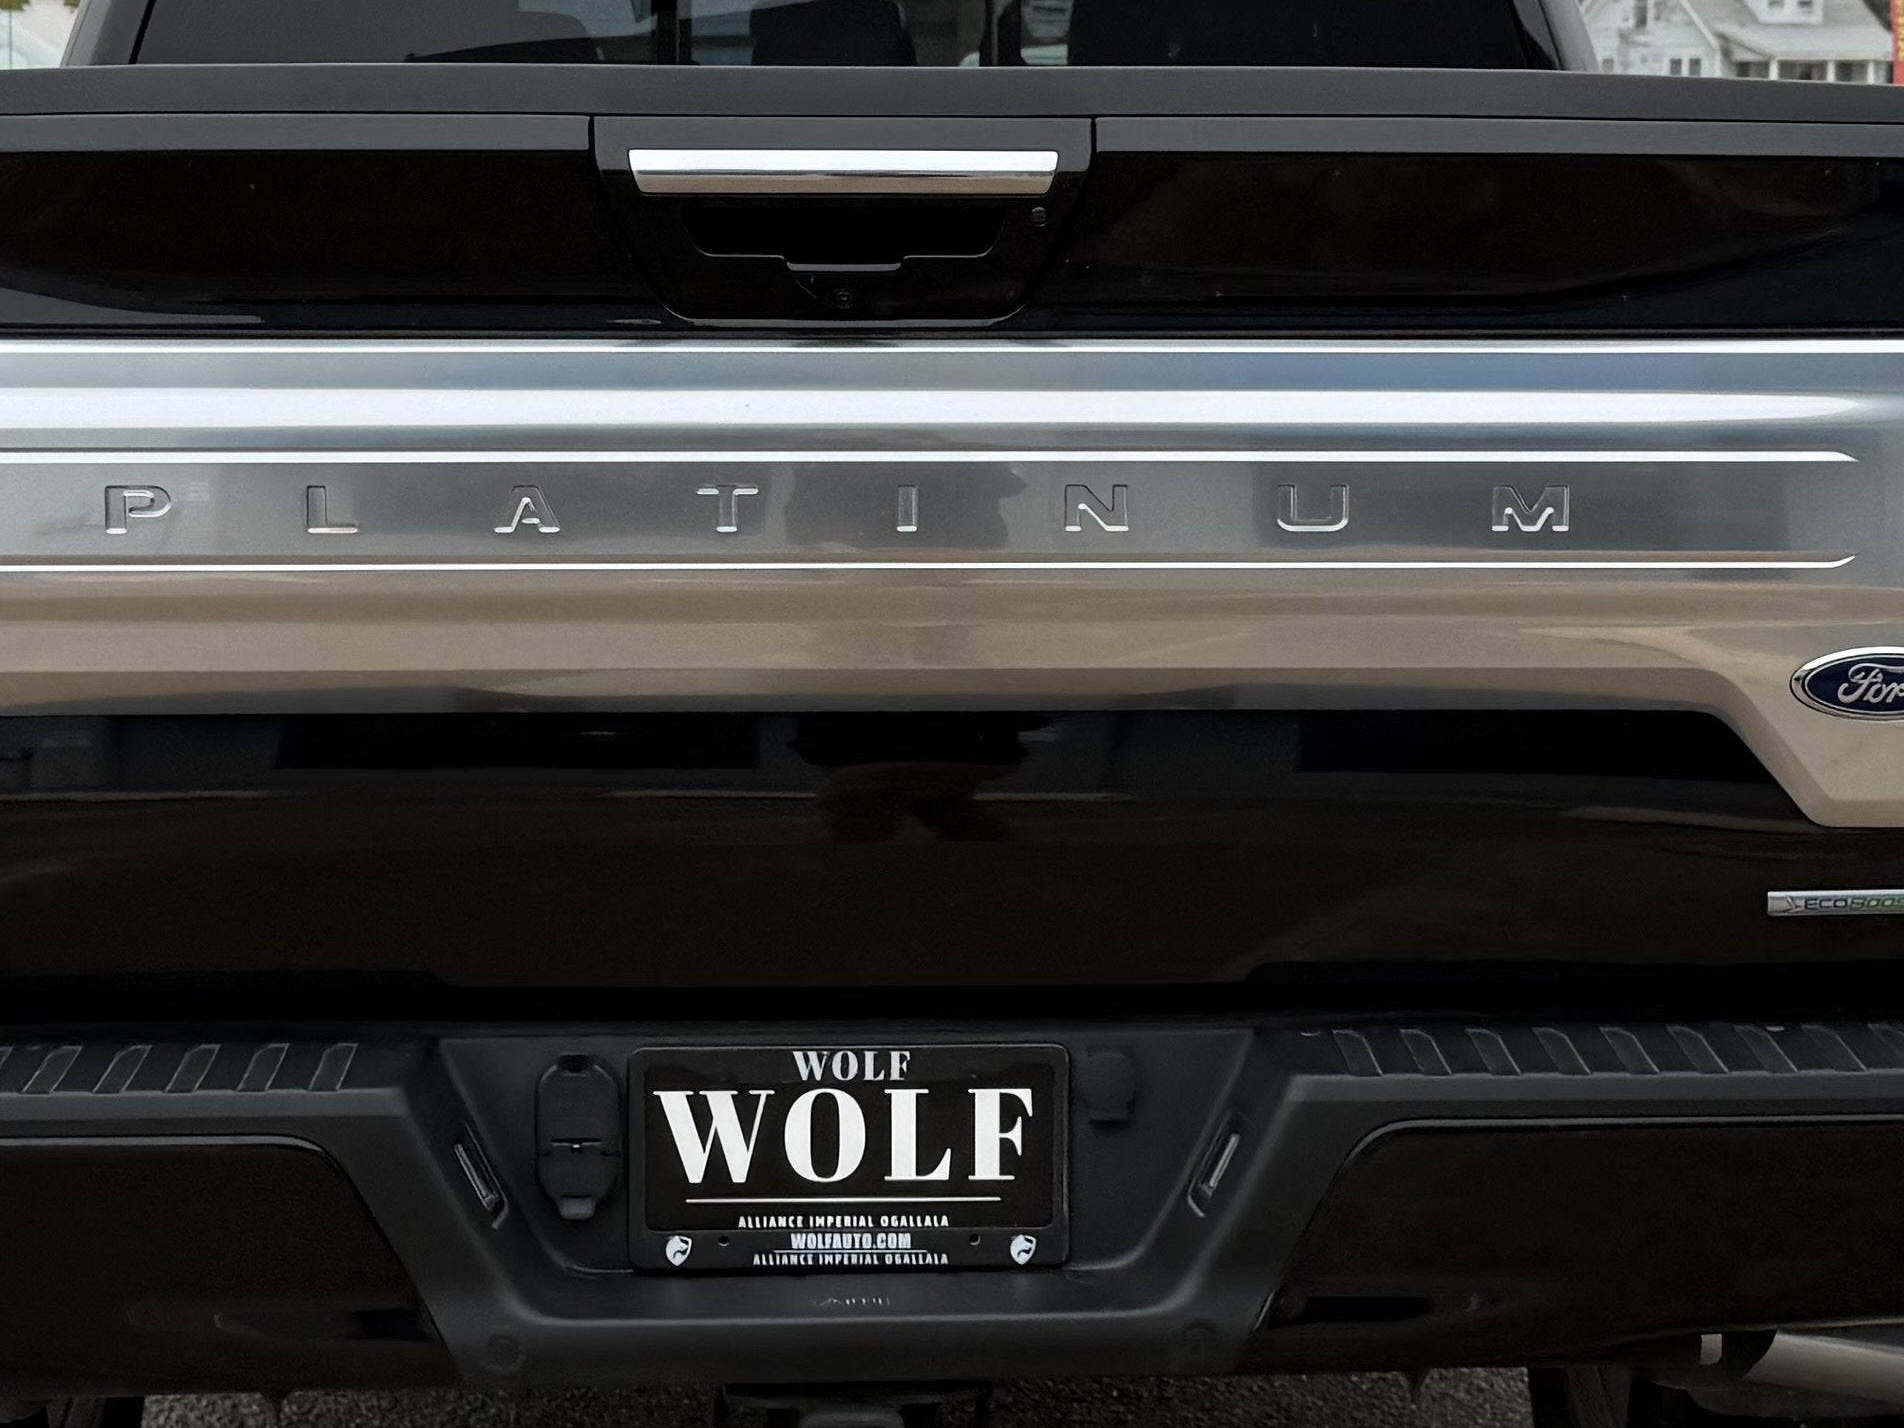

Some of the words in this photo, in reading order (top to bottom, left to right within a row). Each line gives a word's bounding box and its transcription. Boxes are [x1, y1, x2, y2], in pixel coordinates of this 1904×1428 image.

[103, 484, 1571, 534] PLATINUM
[792, 1051, 911, 1081] WOLF
[653, 1088, 1033, 1184] WOLF
[738, 1215, 804, 1228] ALLIANCE
[809, 1215, 874, 1228] IMPERIAL
[880, 1215, 949, 1228] OGALLALA
[790, 1232, 912, 1249] WOLFAUTO.COM
[753, 1253, 813, 1266] ALLIANCE
[819, 1253, 879, 1266] IMPERIAL
[885, 1253, 949, 1266] OGALLALA
